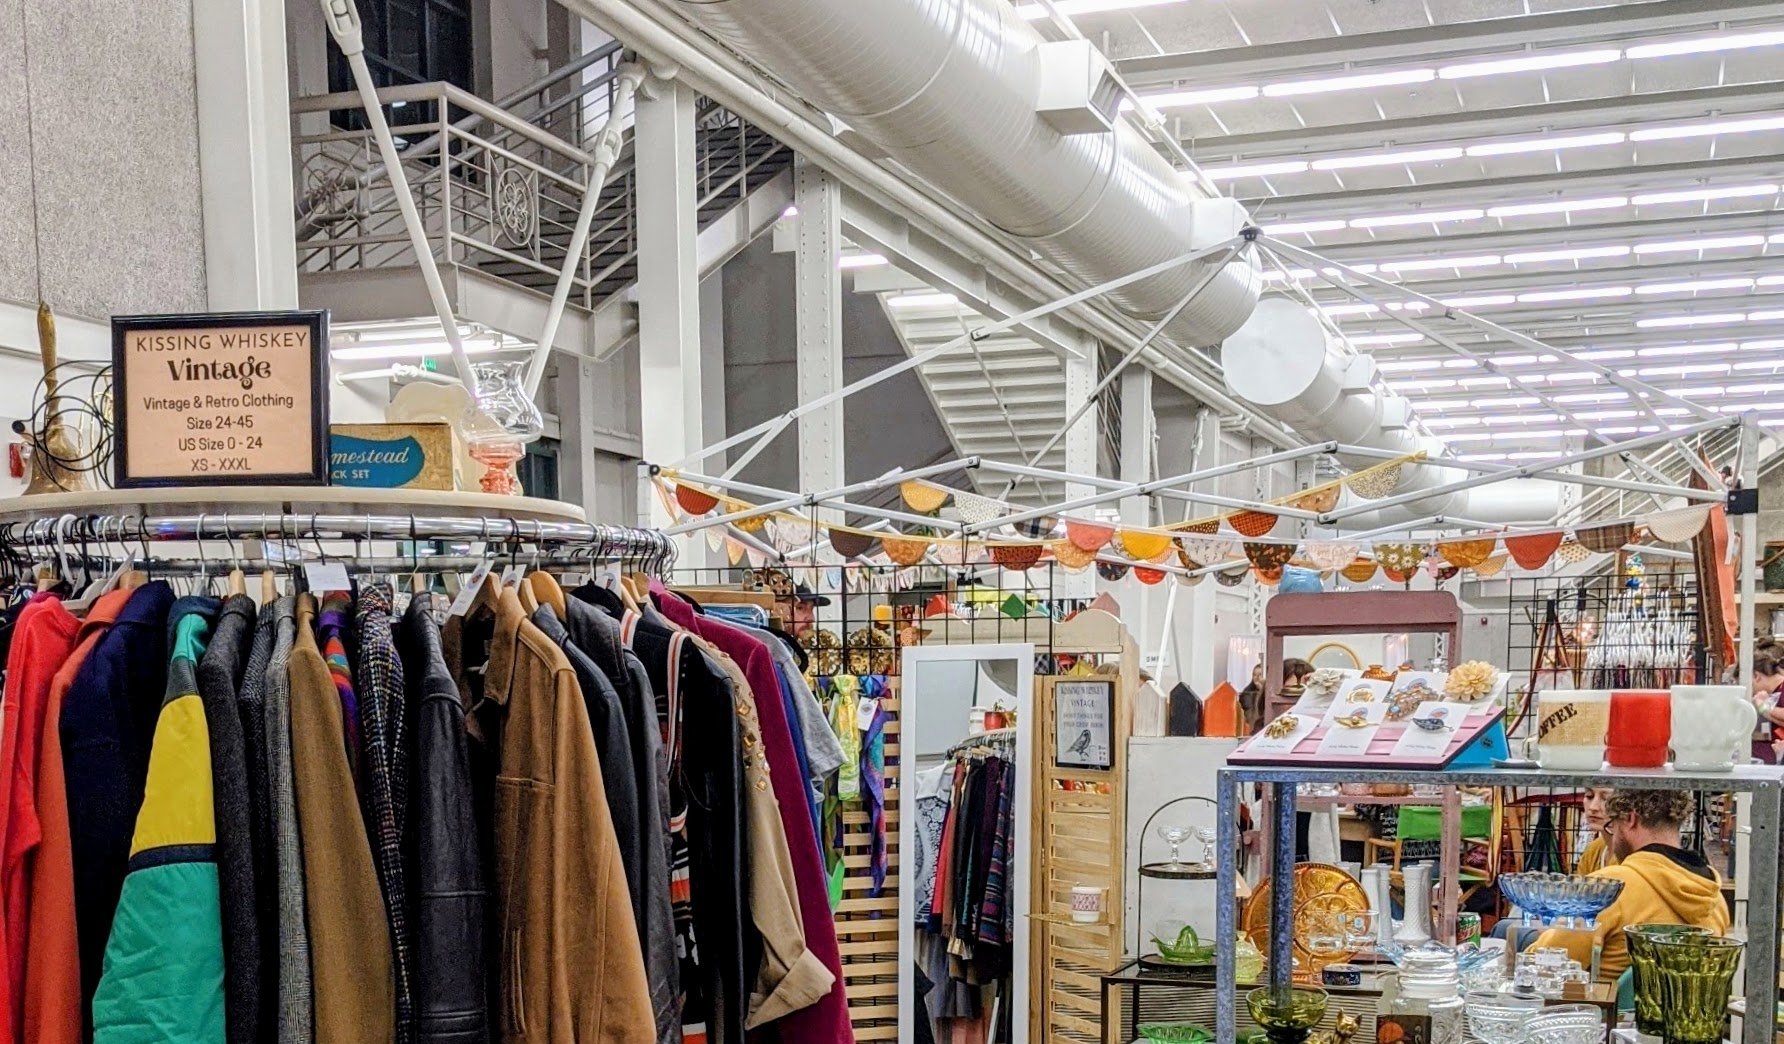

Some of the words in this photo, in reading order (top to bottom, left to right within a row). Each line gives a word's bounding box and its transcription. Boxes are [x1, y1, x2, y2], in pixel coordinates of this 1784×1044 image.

[136, 335, 211, 352] KISSING
[219, 332, 307, 349] WHISKEY
[167, 355, 272, 390] Vintage
[144, 396, 191, 412] Vintage
[194, 396, 203, 409] &
[205, 395, 240, 408] Retro
[242, 393, 294, 409] Clothing
[186, 416, 213, 430] Size
[215, 415, 254, 429] 24-45
[178, 437, 196, 451] US
[199, 437, 225, 451] Size
[227, 437, 236, 450] 0
[246, 436, 263, 449] 24
[191, 458, 208, 472] XS
[218, 457, 252, 471] XXXL
[352, 469, 371, 479] SET
[1538, 703, 1578, 744] OFFEE
